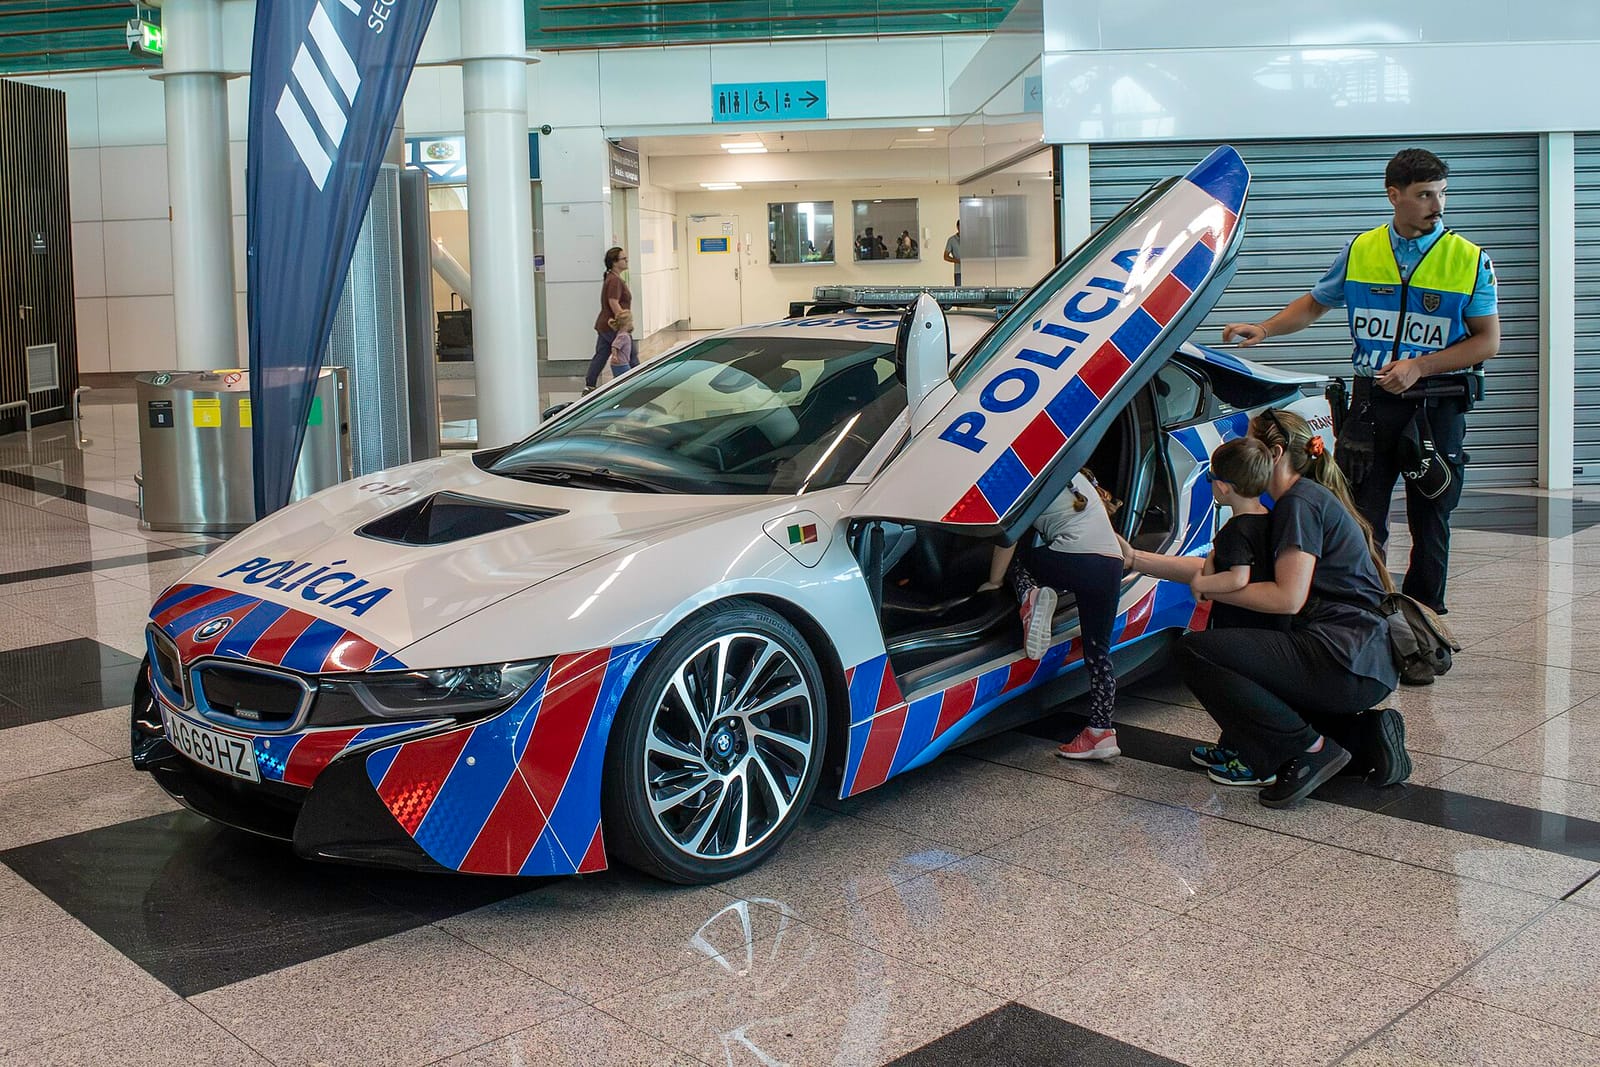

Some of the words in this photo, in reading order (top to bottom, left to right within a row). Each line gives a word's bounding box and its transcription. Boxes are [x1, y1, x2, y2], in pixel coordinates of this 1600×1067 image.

[938, 246, 1167, 454] POLÍCIA
[1354, 315, 1443, 346] POLÍCIA
[217, 556, 393, 617] POLÍCIA
[171, 716, 252, 777] AG69HZ
